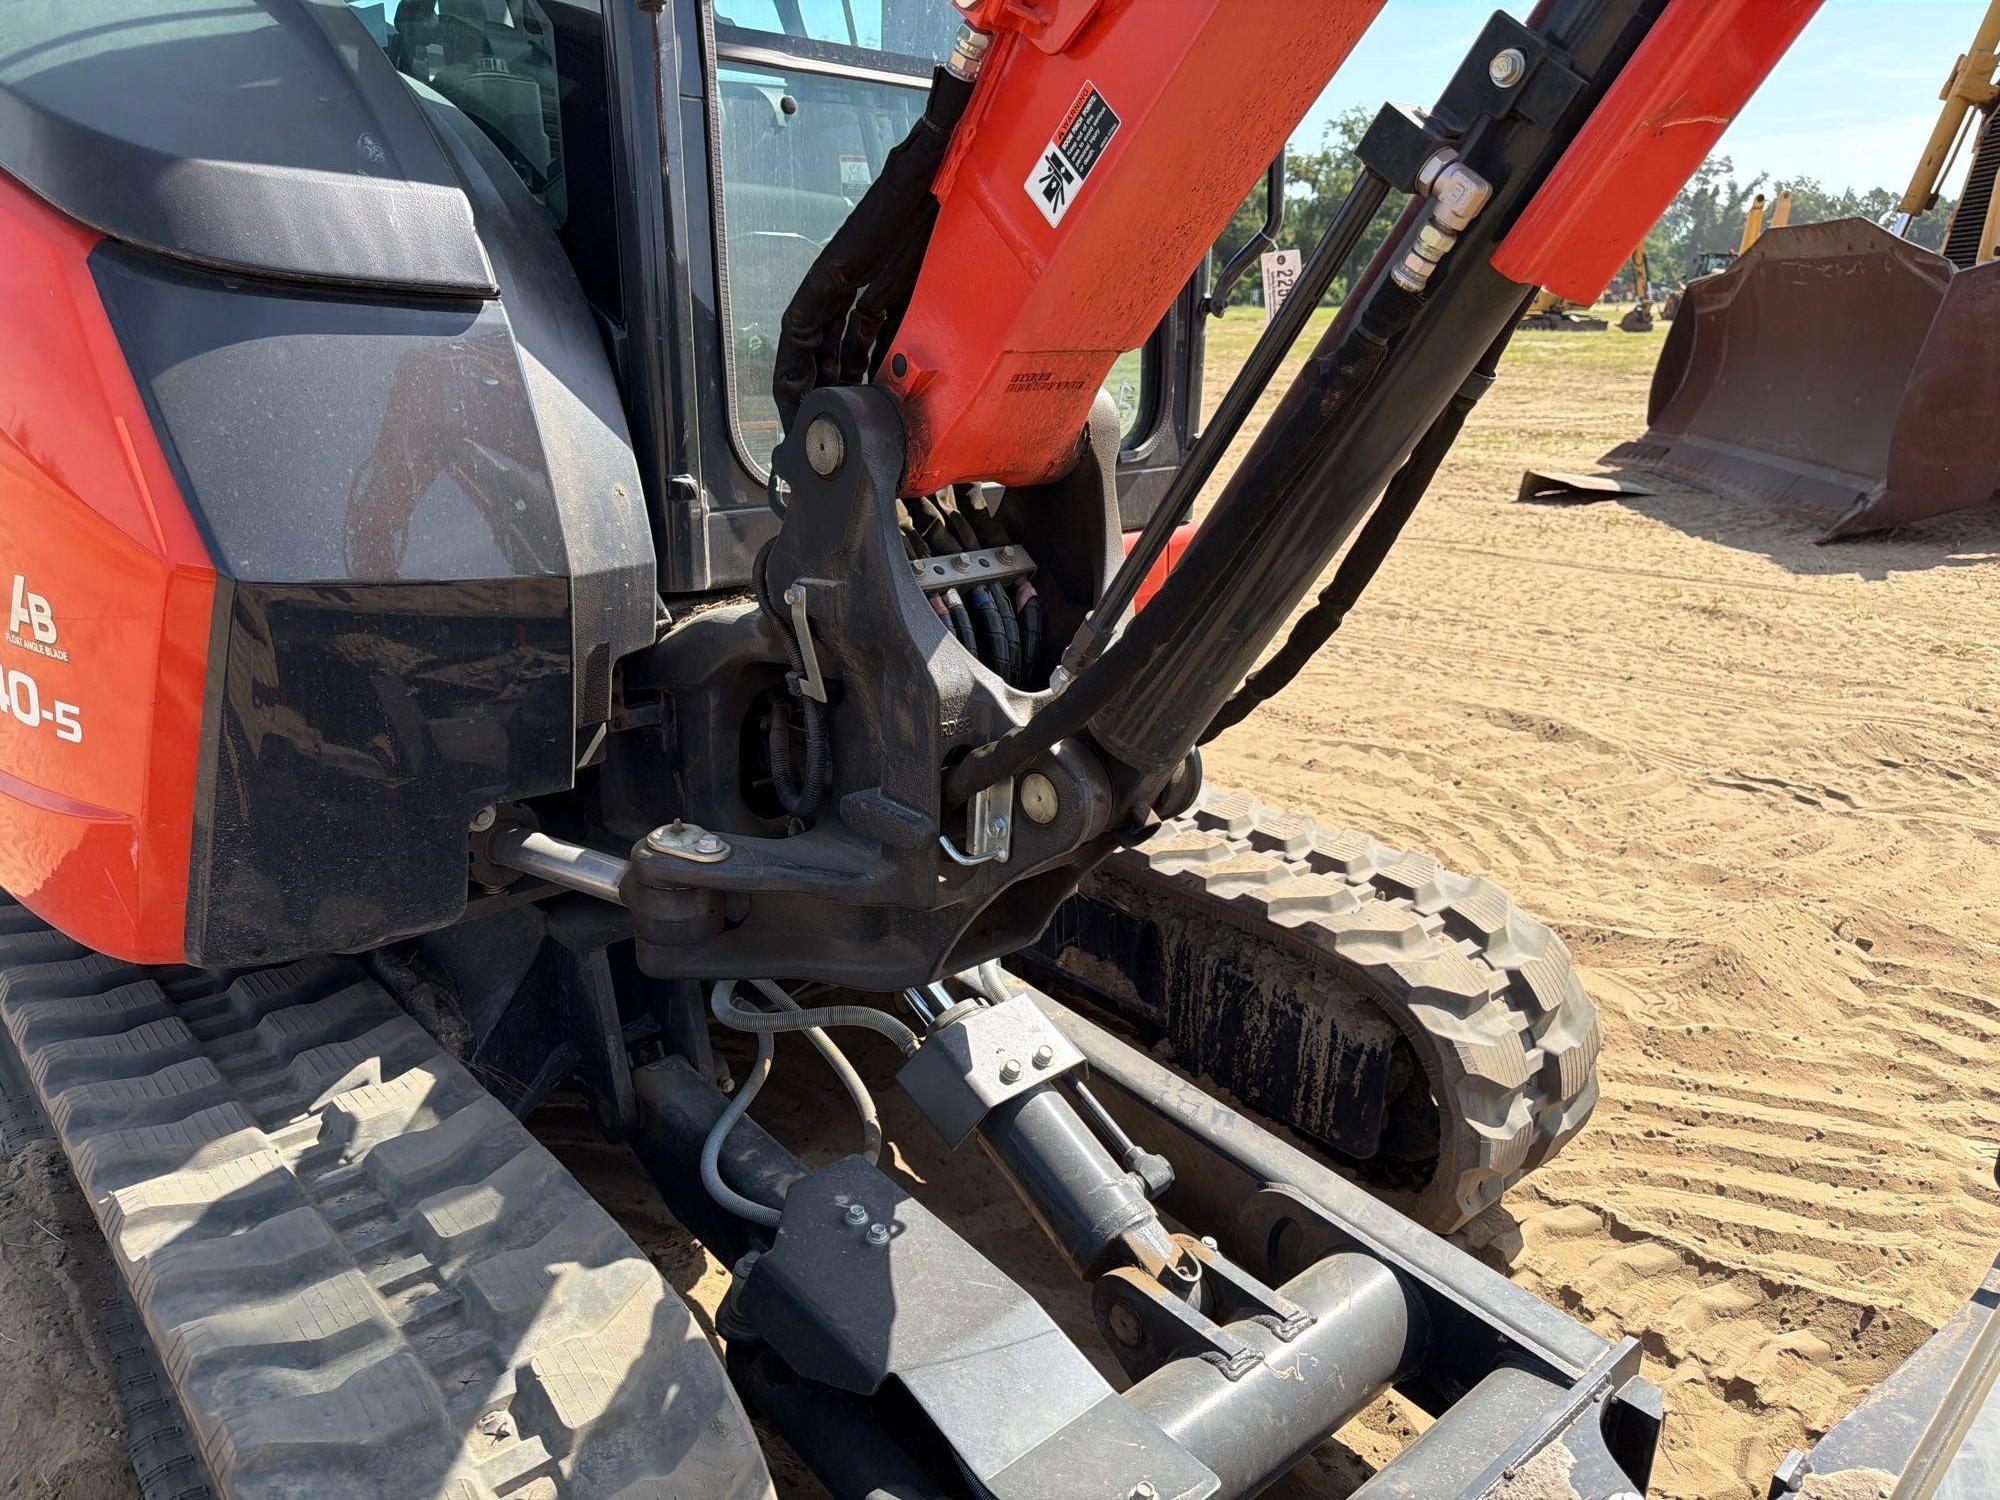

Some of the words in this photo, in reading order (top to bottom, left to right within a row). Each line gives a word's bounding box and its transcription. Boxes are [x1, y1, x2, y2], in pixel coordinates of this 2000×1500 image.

[1063, 89, 1089, 129] WARNING
[1084, 126, 1093, 141] avoid
[1093, 106, 1106, 126] serious
[1062, 132, 1073, 150] BOOM
[1072, 116, 1083, 134] PINCH
[1067, 141, 1077, 156] Keep
[1075, 143, 1090, 167] personal
[1090, 128, 1100, 144] injury
[5, 632, 23, 649] FLOAT
[24, 641, 45, 655] ANGLE
[45, 645, 69, 662] BLADE
